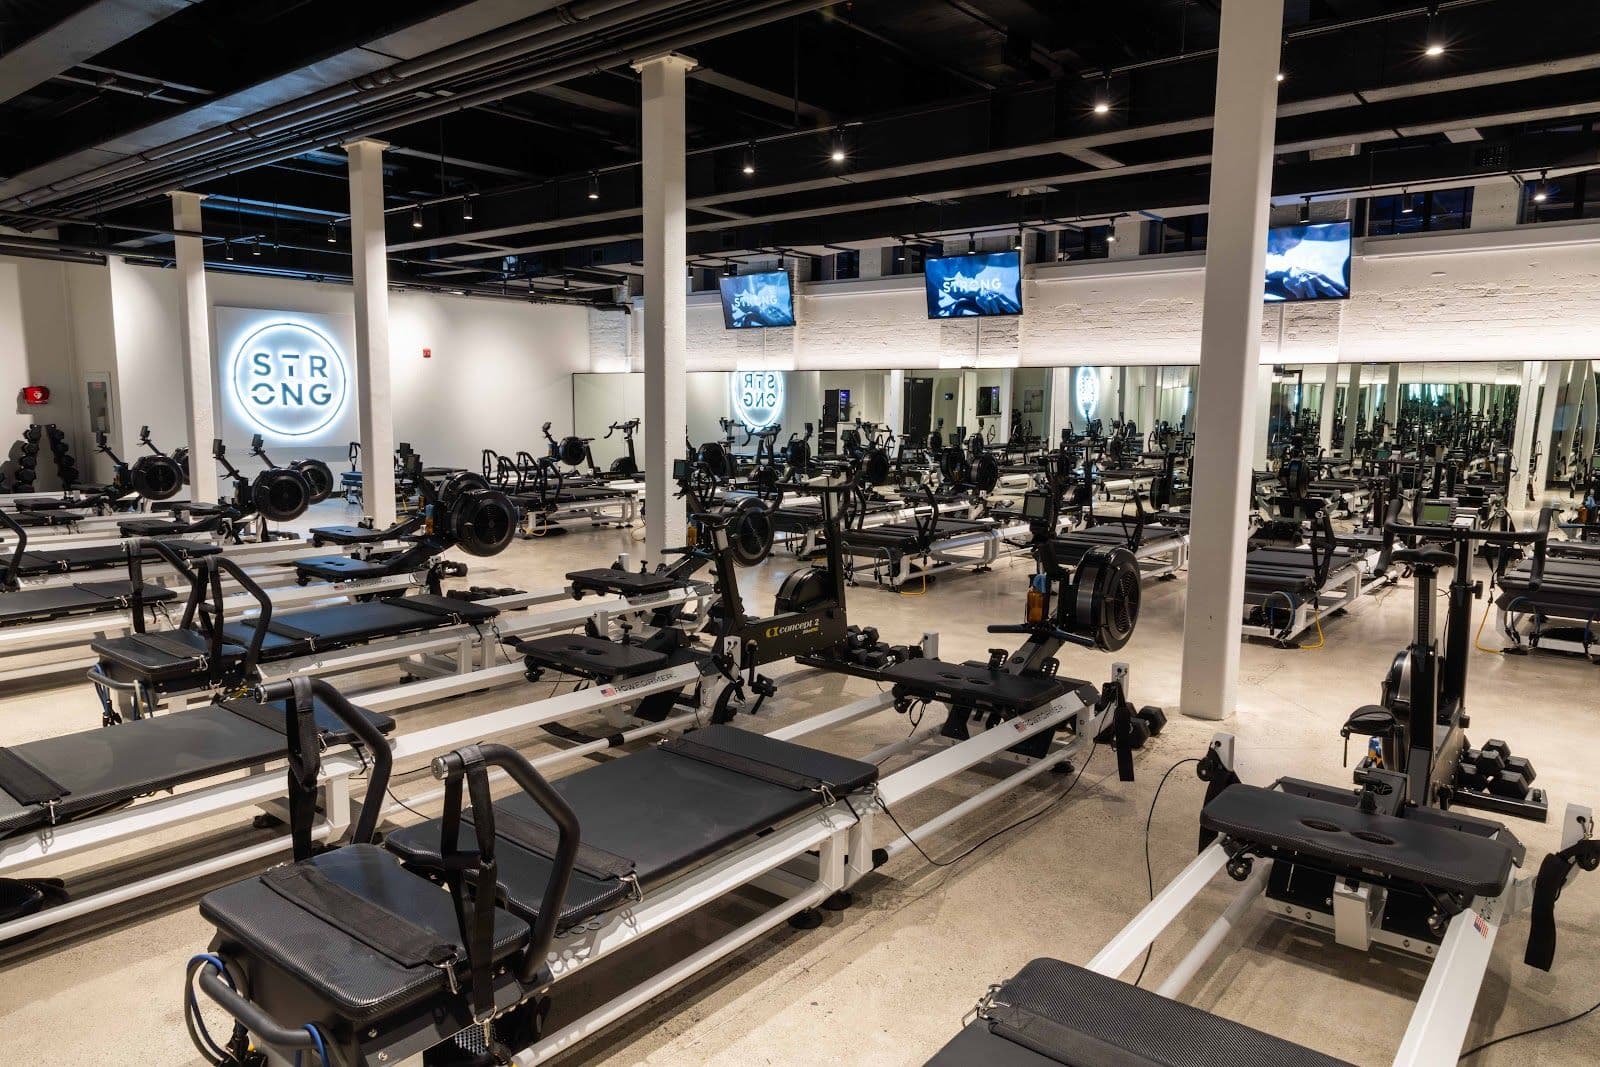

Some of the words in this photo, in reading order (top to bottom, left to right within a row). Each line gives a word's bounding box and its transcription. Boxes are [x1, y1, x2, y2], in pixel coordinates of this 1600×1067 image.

[943, 278, 1002, 293] STRONG
[734, 294, 778, 307] STRNG
[253, 353, 328, 378] STR
